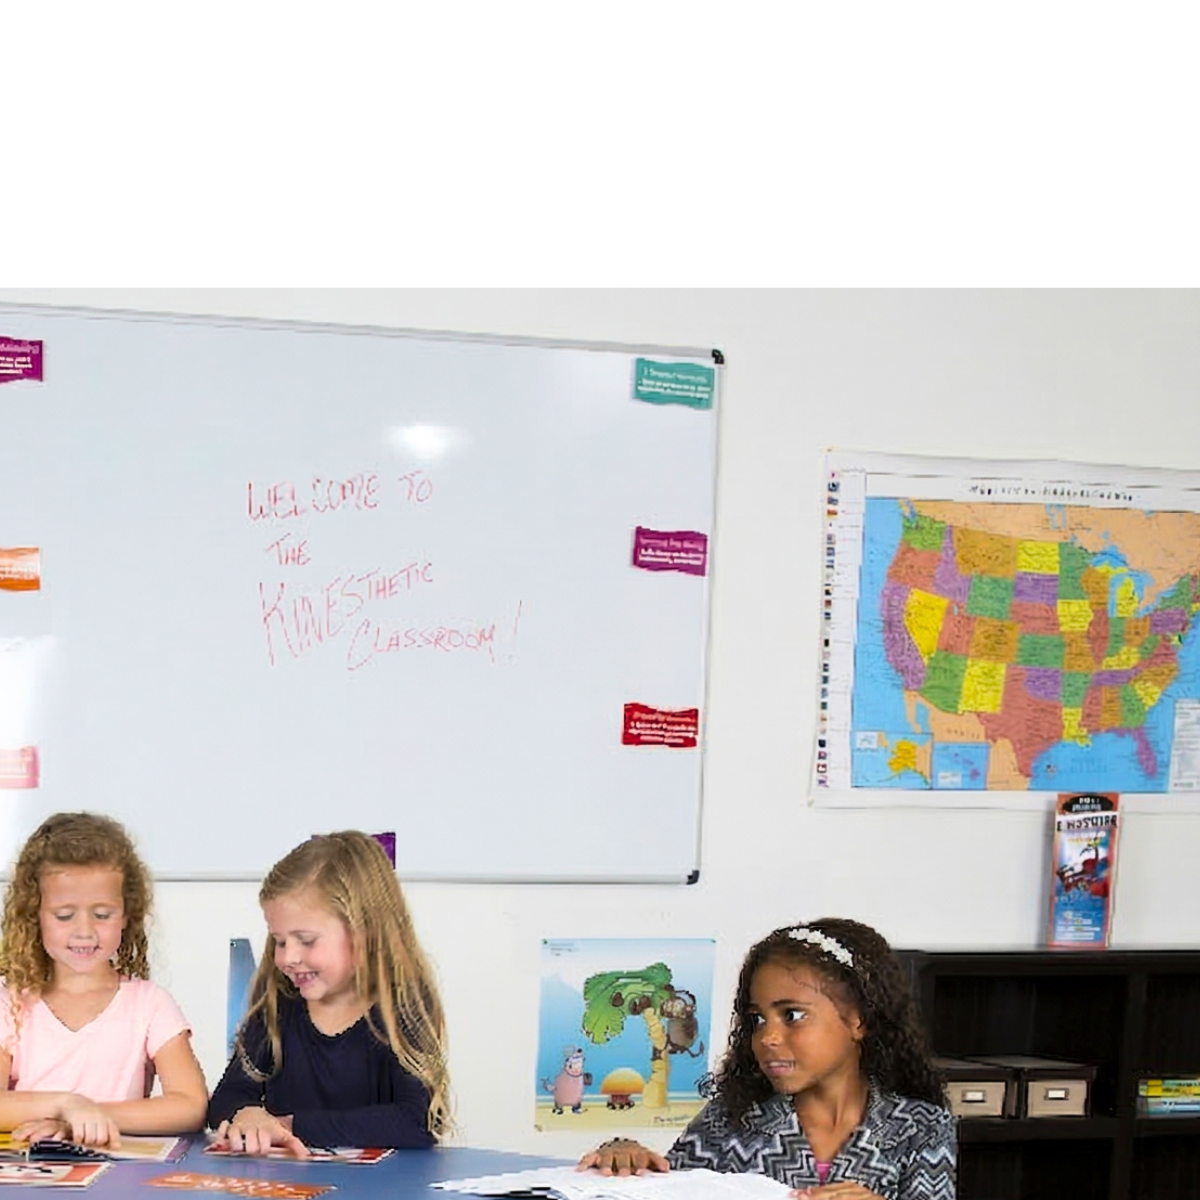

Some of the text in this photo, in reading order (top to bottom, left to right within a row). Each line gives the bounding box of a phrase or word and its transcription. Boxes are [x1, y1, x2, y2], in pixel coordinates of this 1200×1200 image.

[247, 470, 433, 520] WELCOME TO
[264, 532, 312, 566] THE
[258, 562, 434, 667] KINESTHETIC
